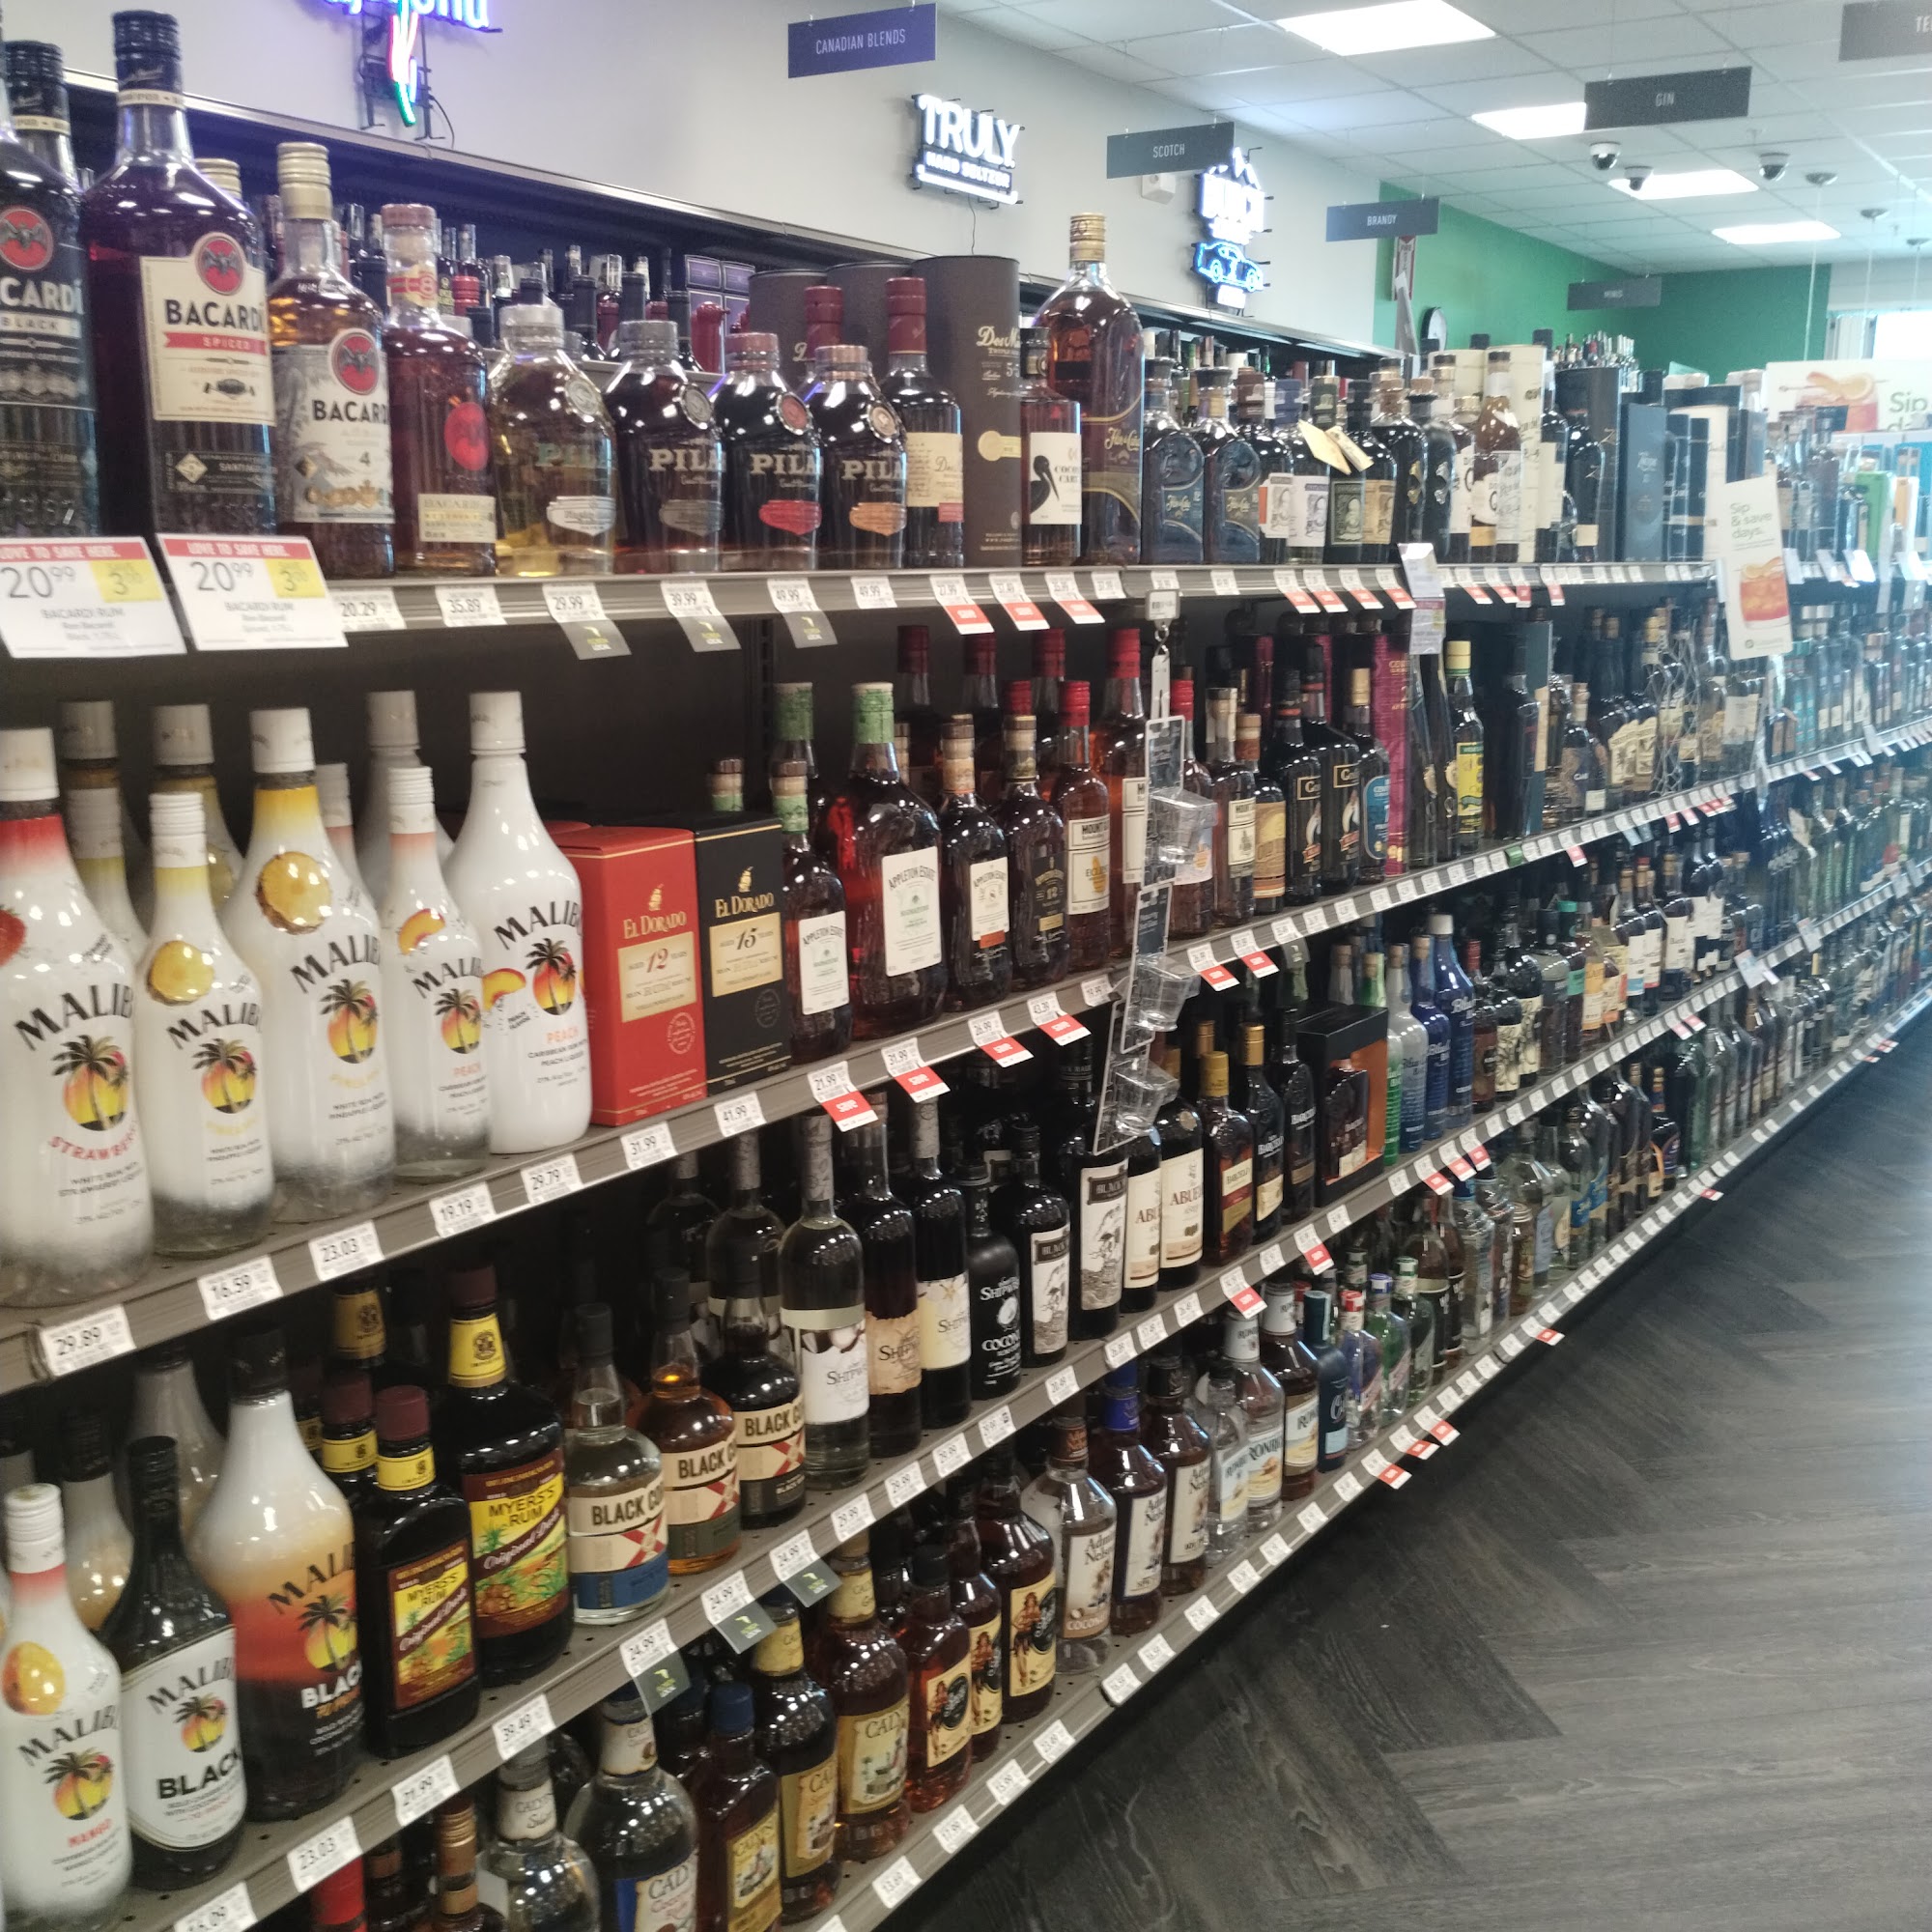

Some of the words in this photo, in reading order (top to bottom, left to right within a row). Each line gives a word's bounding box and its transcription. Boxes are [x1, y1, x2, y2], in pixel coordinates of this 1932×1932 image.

[1916, 14, 1932, 34] TE
[815, 33, 864, 55] CANADIAN
[867, 28, 906, 48] BLENDS
[1655, 93, 1675, 107] GIN
[918, 95, 1020, 167] TRULY
[1152, 144, 1185, 158] SCOTCH
[924, 151, 961, 175] HARD
[961, 161, 1011, 189] SELTZER
[1367, 213, 1397, 227] BRANDY
[1, 315, 60, 331] BLACK
[1729, 502, 1750, 517] Sip
[1731, 515, 1741, 526] &
[1743, 512, 1774, 526] save
[1732, 526, 1761, 540] days
[31, 546, 48, 559] TO
[48, 545, 85, 559] SAVE
[187, 542, 213, 555] LOVE
[216, 543, 233, 556] TO
[233, 543, 261, 557] SAVE
[552, 595, 583, 611] 29.99
[669, 592, 697, 607] 39.99
[715, 898, 729, 918] EL
[731, 892, 775, 914] DORADO
[493, 899, 583, 951] MALIB
[623, 919, 638, 939] EL
[640, 911, 687, 935] DORADO
[737, 927, 758, 951] 15
[290, 934, 381, 994] MALIB
[646, 948, 669, 974] 12
[14, 982, 134, 1051] MALIB
[166, 1002, 263, 1050] MALIB
[745, 1411, 790, 1436] BLACK
[678, 1450, 724, 1479] BLACK
[488, 1484, 555, 1518] MYERS'S
[591, 1500, 645, 1526] BLACK
[509, 1505, 543, 1528] RUM
[420, 1588, 447, 1608] RUM
[147, 1656, 235, 1715] MALIB
[18, 1704, 120, 1767] MALIB
